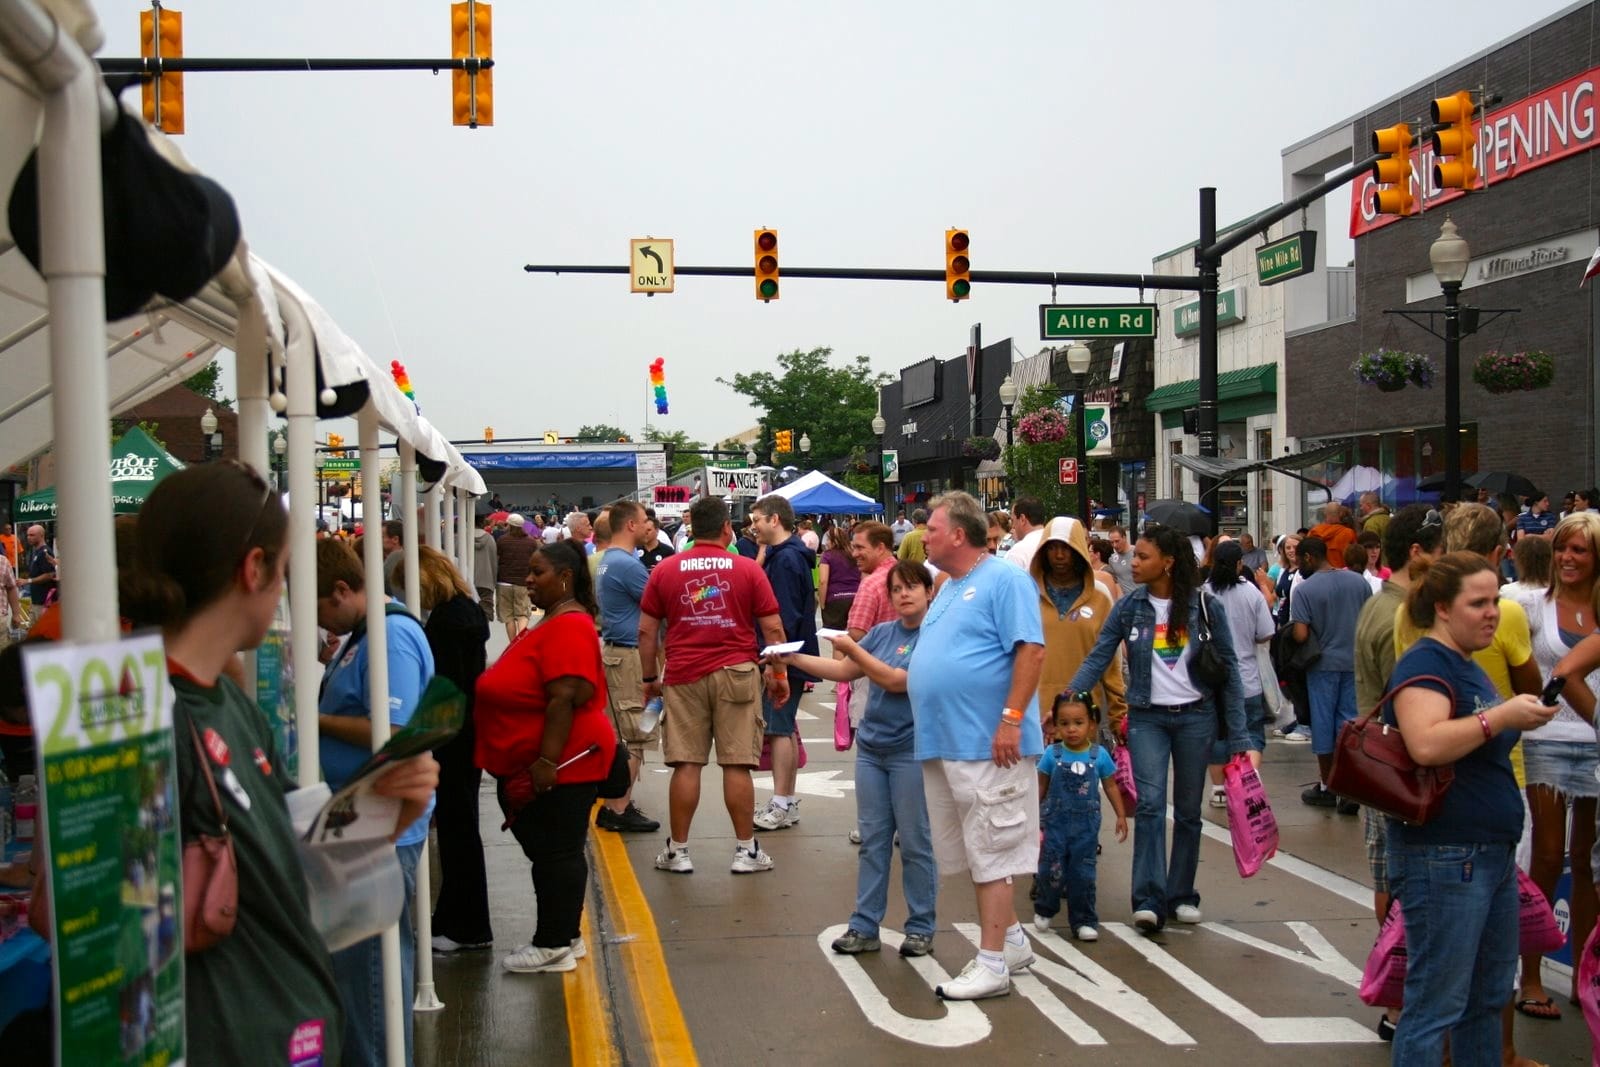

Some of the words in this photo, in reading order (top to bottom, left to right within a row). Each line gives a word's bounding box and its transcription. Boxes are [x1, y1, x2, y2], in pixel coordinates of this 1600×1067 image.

[1361, 149, 1447, 222] GND
[1471, 82, 1594, 176] PENING
[1259, 256, 1274, 273] Nine
[1274, 250, 1289, 268] Mile
[1290, 245, 1299, 263] Rd
[638, 275, 667, 286] ONLY
[1057, 314, 1109, 329] Allen
[1119, 313, 1144, 328] Rd
[110, 467, 154, 477] OODS
[712, 471, 758, 489] TRIANGLE
[20, 500, 48, 513] Where
[680, 556, 733, 571] DIRECTOR
[34, 648, 165, 755] 2007
[817, 922, 1390, 1047] ONLY
